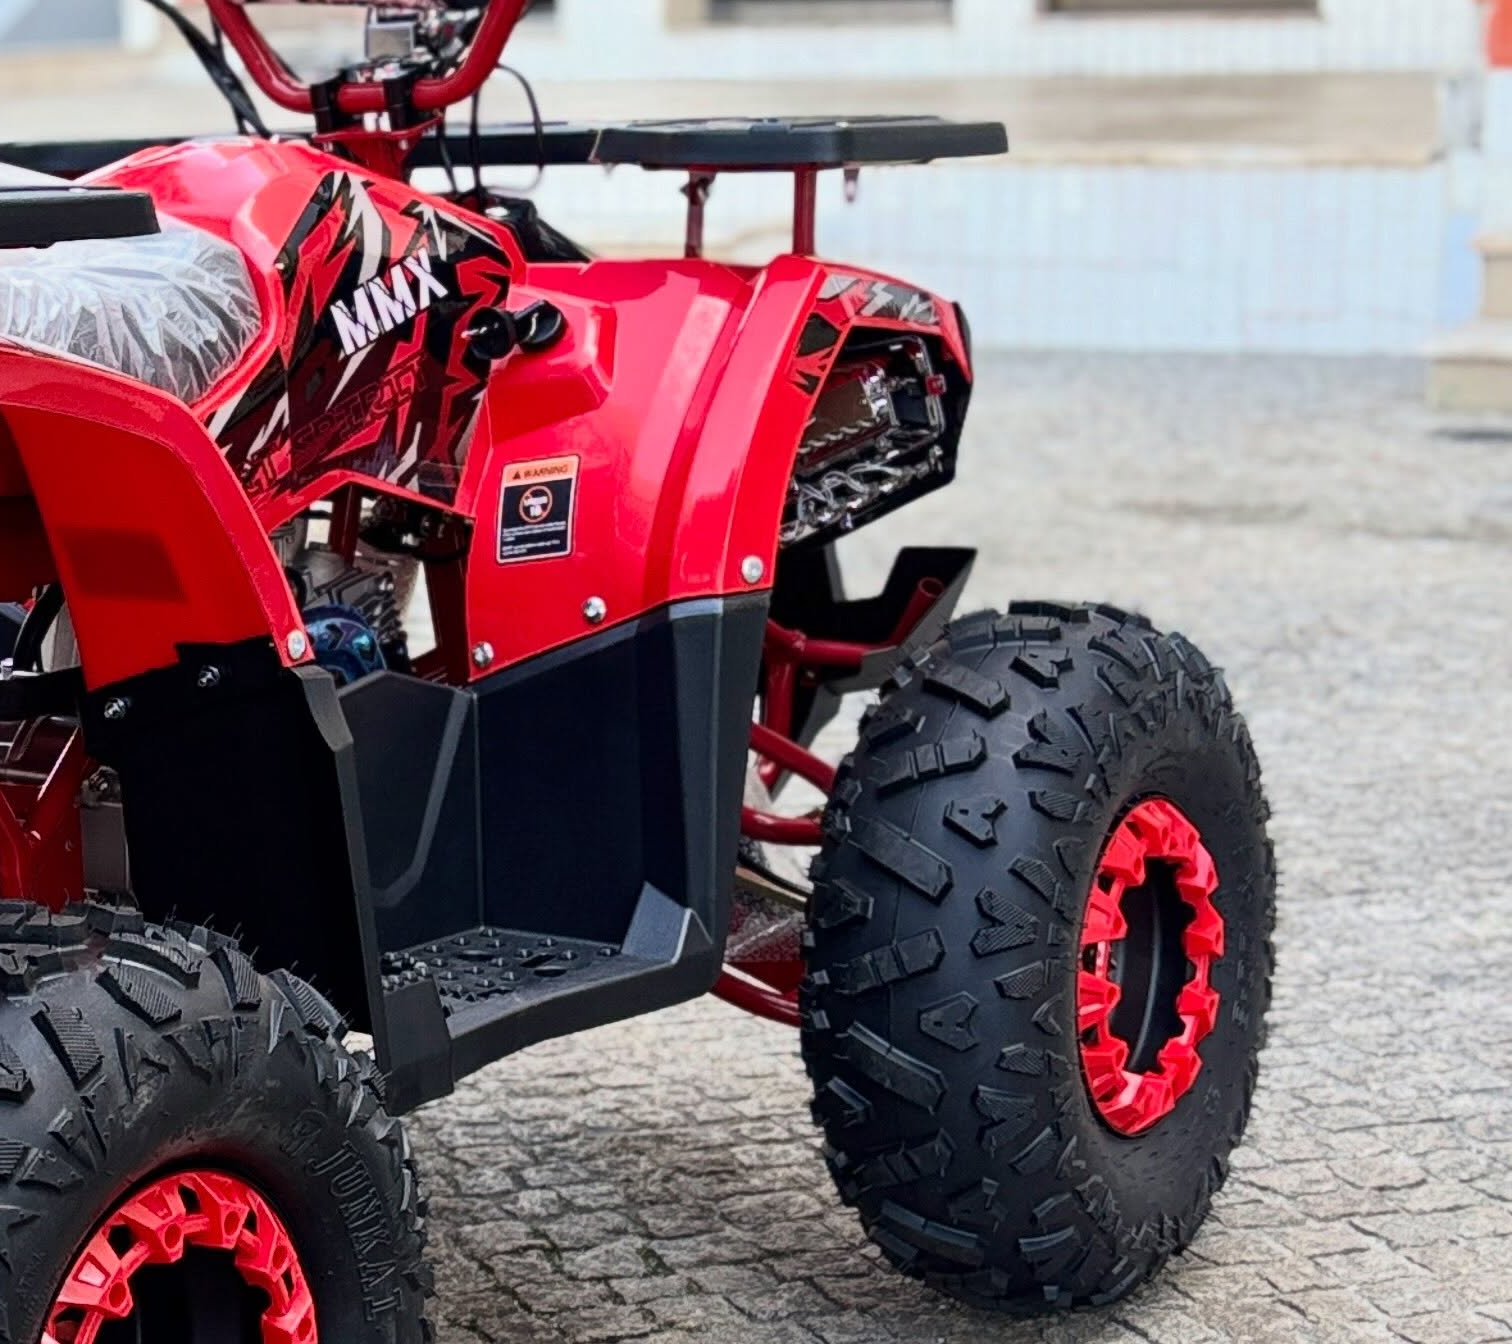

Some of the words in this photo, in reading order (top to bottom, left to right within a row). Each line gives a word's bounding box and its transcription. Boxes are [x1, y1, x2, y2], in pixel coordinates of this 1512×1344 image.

[330, 245, 448, 356] MMX
[524, 465, 568, 477] WARNING
[304, 1140, 404, 1322] JUNKAI
